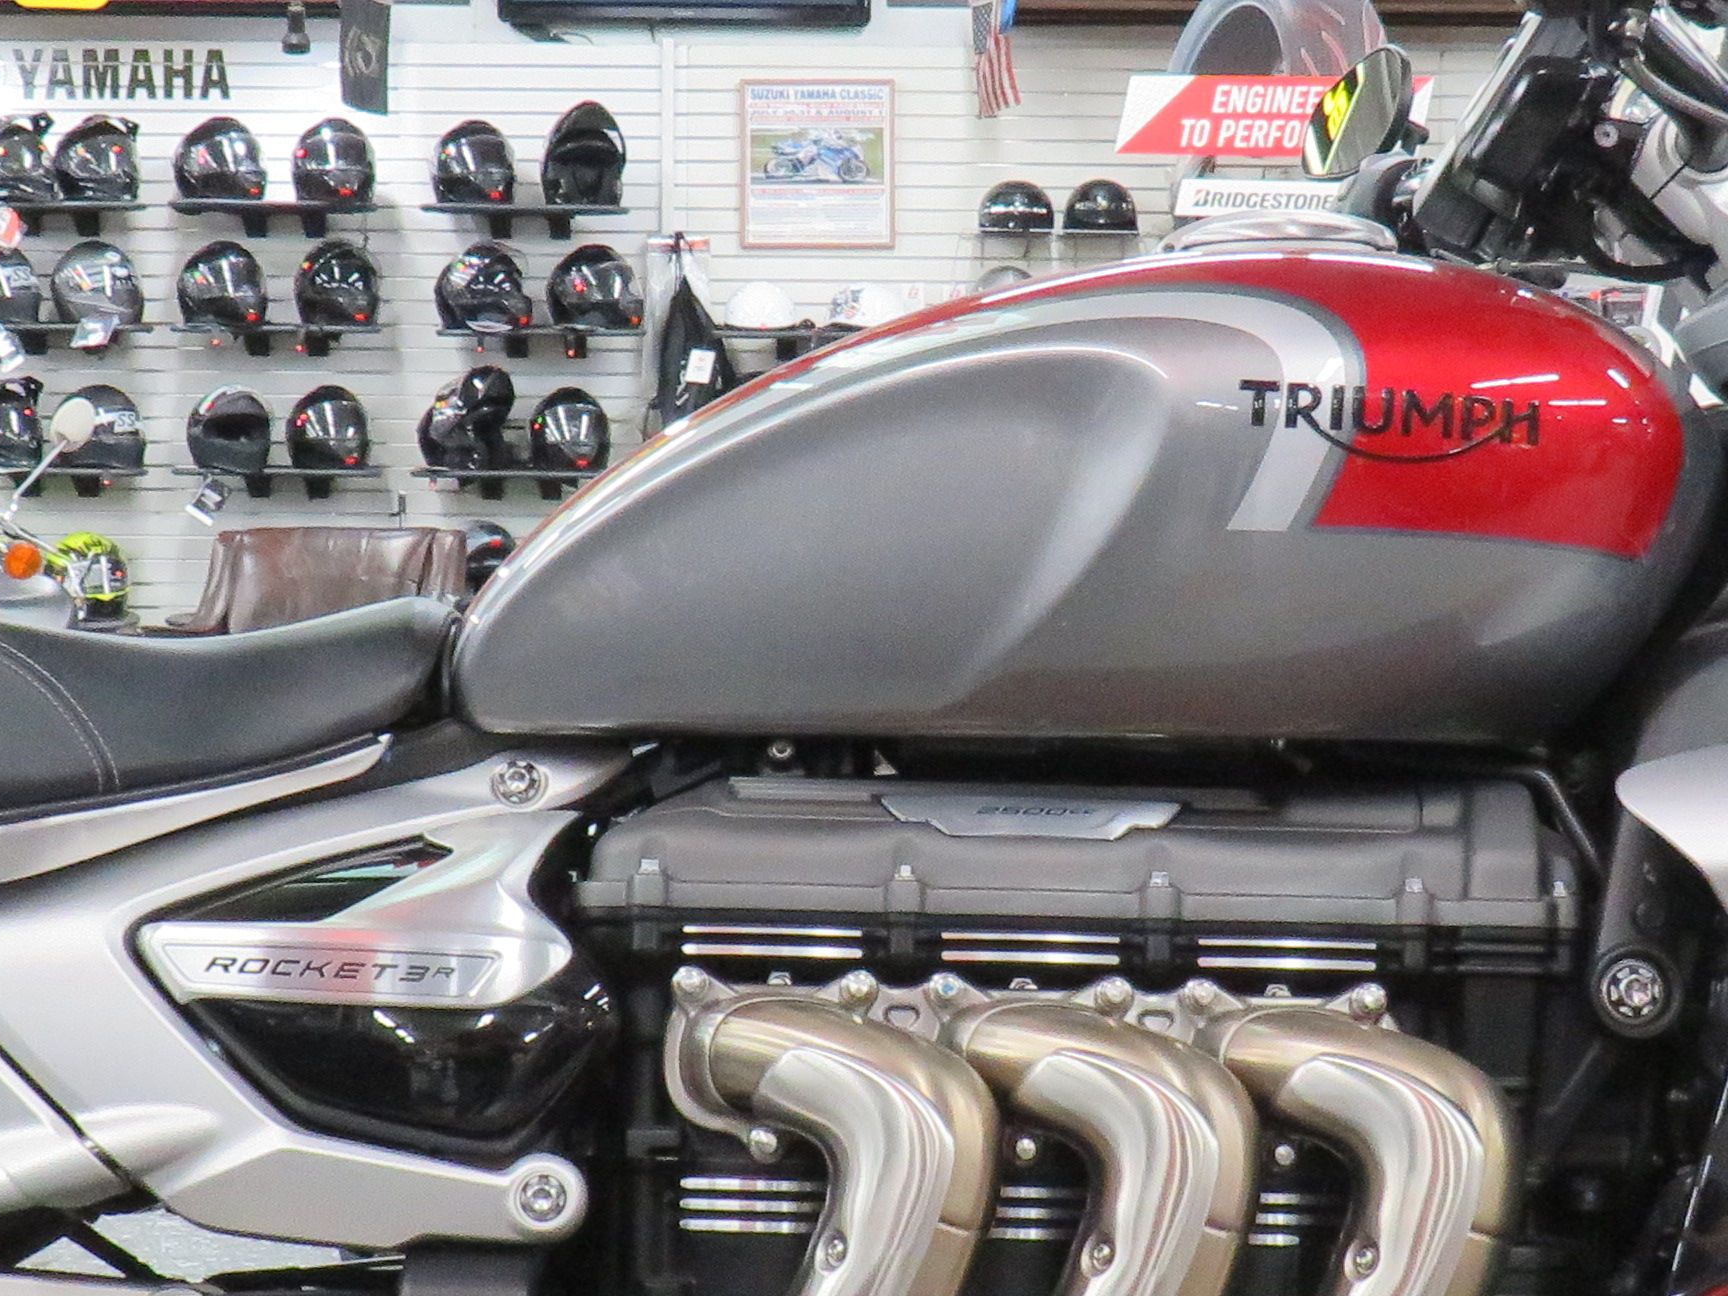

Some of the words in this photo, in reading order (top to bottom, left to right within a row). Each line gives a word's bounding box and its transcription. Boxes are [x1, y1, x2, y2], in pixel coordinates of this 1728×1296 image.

[12, 48, 232, 100] YAMAHA
[750, 88, 790, 100] SUZUKI
[793, 88, 837, 100] YAMAHA
[839, 88, 884, 100] CLASSIC
[1211, 83, 1330, 115] ENGINEE
[1180, 119, 1210, 148] TO
[1217, 118, 1308, 149] PERFO
[1193, 189, 1336, 210] BRIDGESTONE
[1238, 378, 1542, 464] TRIUMPH
